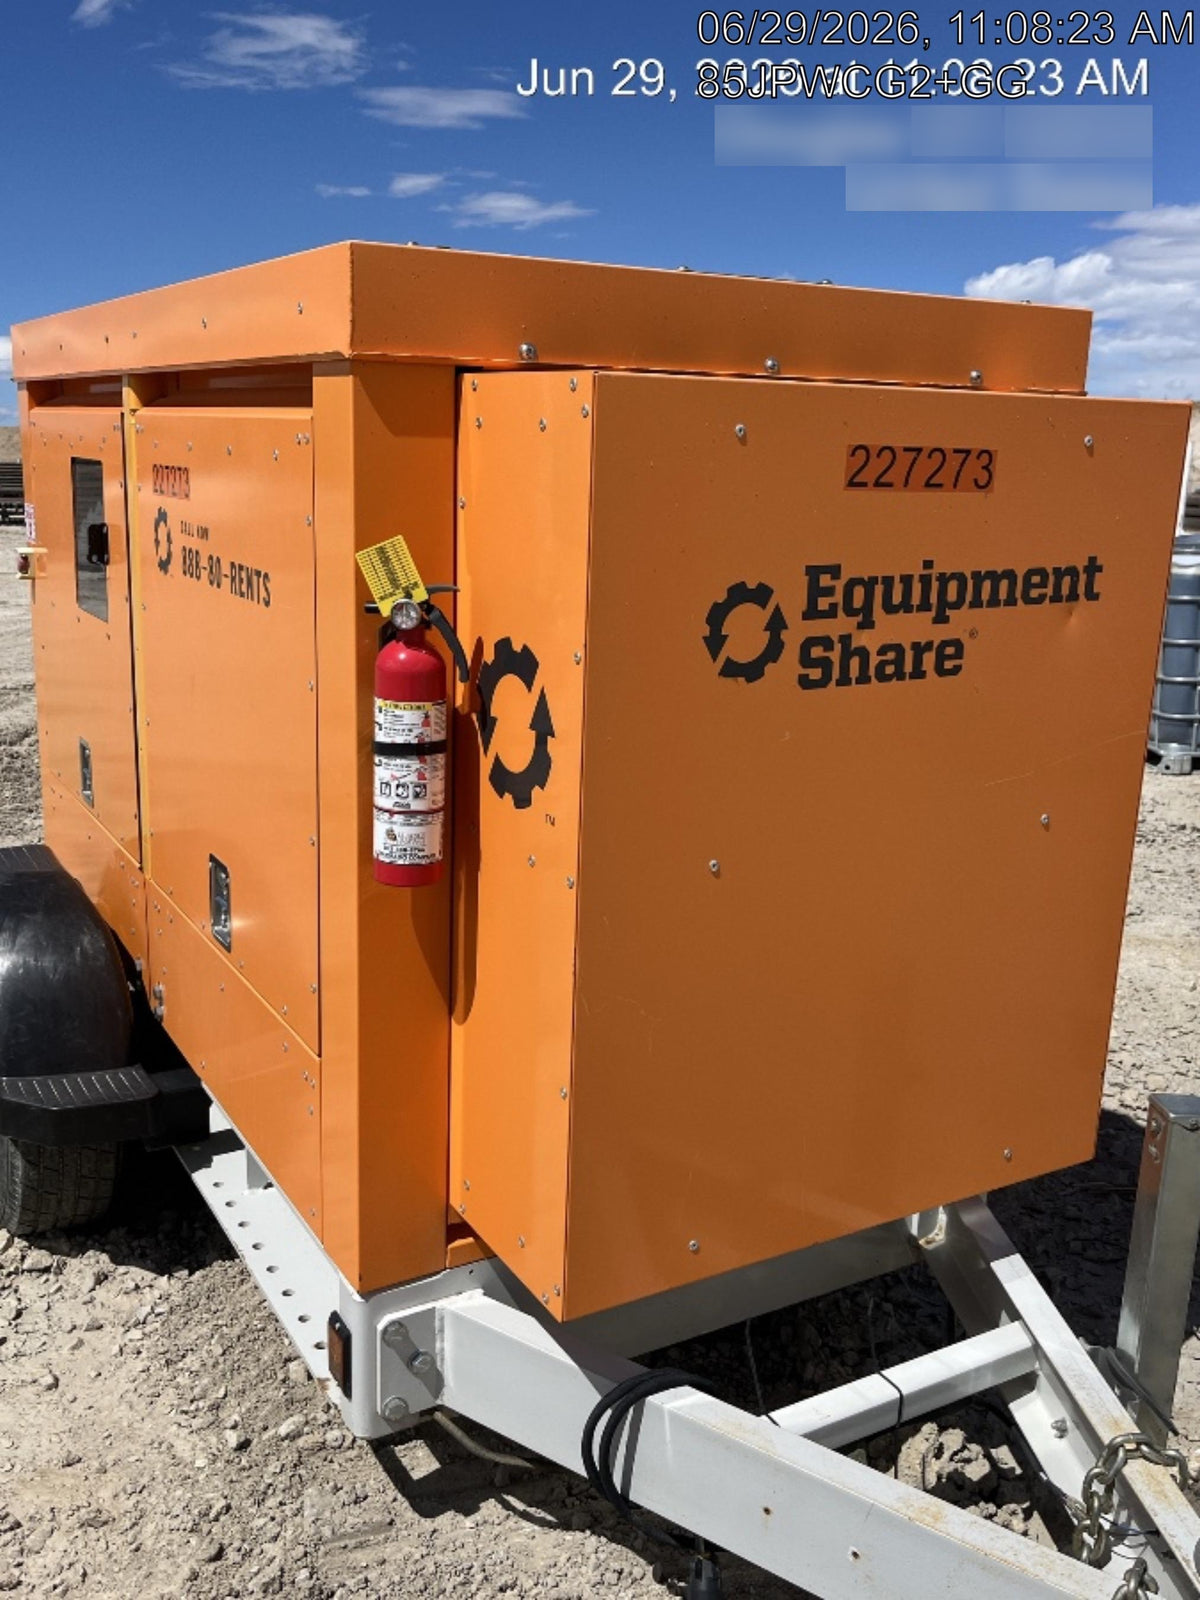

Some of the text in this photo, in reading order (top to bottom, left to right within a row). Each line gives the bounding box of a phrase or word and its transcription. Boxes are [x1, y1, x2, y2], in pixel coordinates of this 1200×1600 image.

[152, 463, 190, 498] 227273
[846, 444, 994, 490] 227273
[181, 545, 271, 608] 888-80-RENTS
[801, 556, 1103, 630] Equipment
[798, 632, 965, 690] Share
